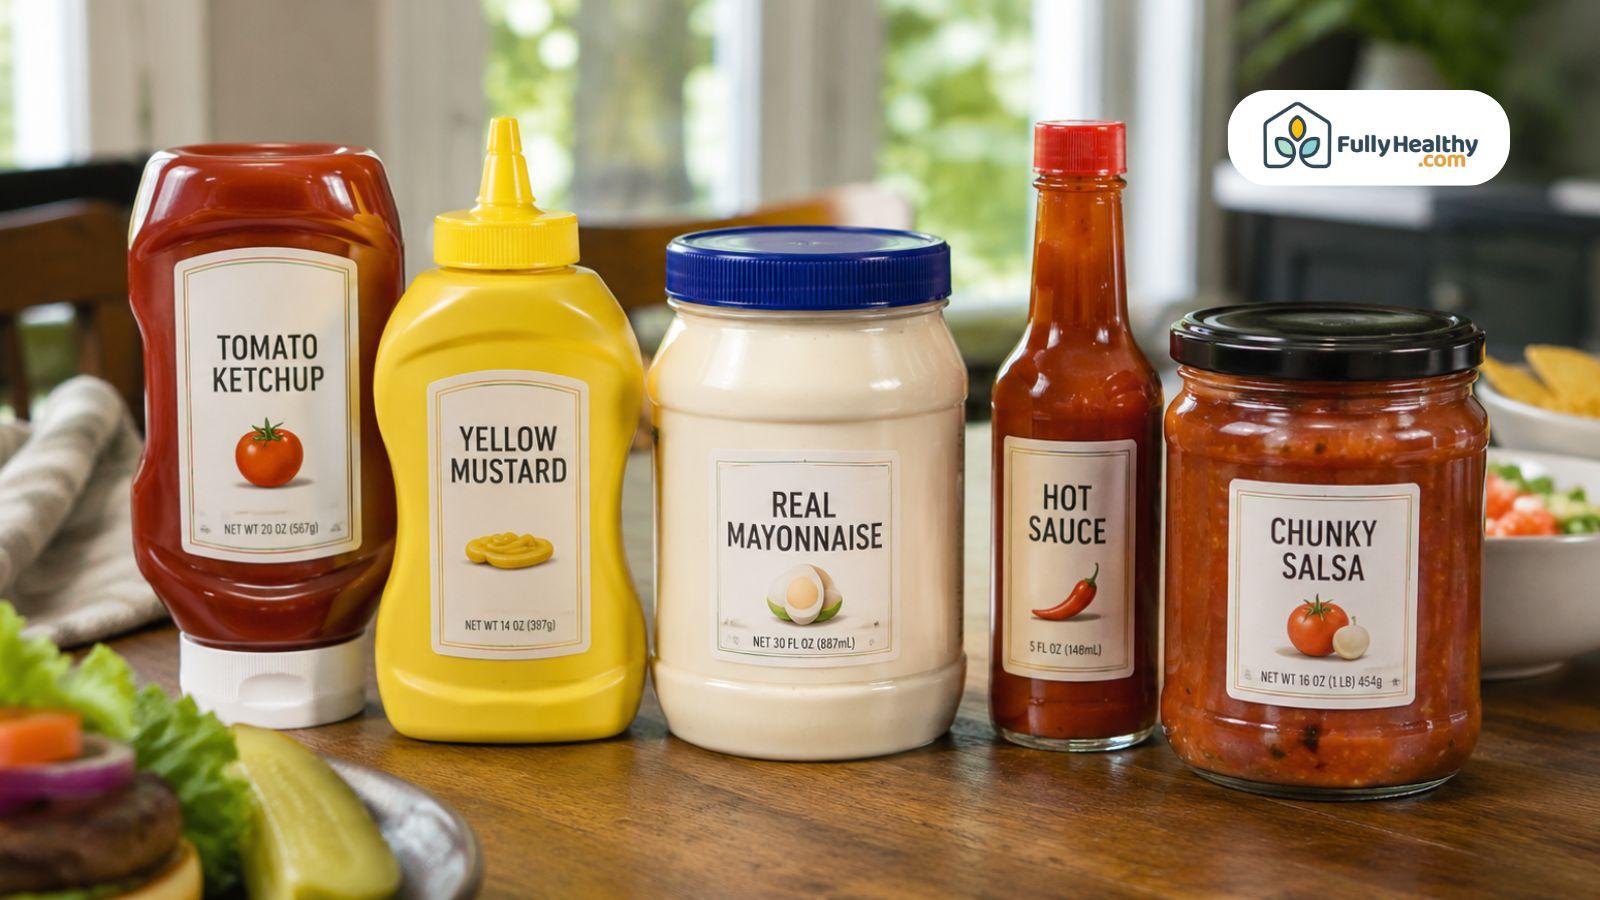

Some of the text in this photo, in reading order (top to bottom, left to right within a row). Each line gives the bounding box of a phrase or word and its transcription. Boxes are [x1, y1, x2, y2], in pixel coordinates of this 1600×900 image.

[217, 334, 318, 360] TOMATO
[213, 366, 324, 392] KETCHUP
[460, 425, 557, 452] YELLOW
[451, 457, 567, 484] MUSTARD
[772, 491, 836, 518] REAL
[1043, 484, 1092, 511] HOT
[224, 522, 318, 535] NET WT 20 OZ (567g)
[727, 522, 882, 552] MAYONNAISE
[1029, 516, 1106, 545] SAUCE
[1270, 517, 1377, 547] CHUNKY
[1282, 552, 1365, 581] SALSA
[465, 619, 556, 632] NET WT 14 OZ (387g)
[753, 636, 855, 650] NET 30 FL OZ (887mL)
[1030, 641, 1035, 652] 5
[1038, 642, 1047, 653] FL
[1050, 643, 1061, 654] OZ
[1261, 671, 1278, 683] NET
[1281, 673, 1296, 685] WT
[1300, 675, 1310, 686] 16
[1313, 675, 1325, 687] OZ
[1340, 675, 1355, 688] LB)
